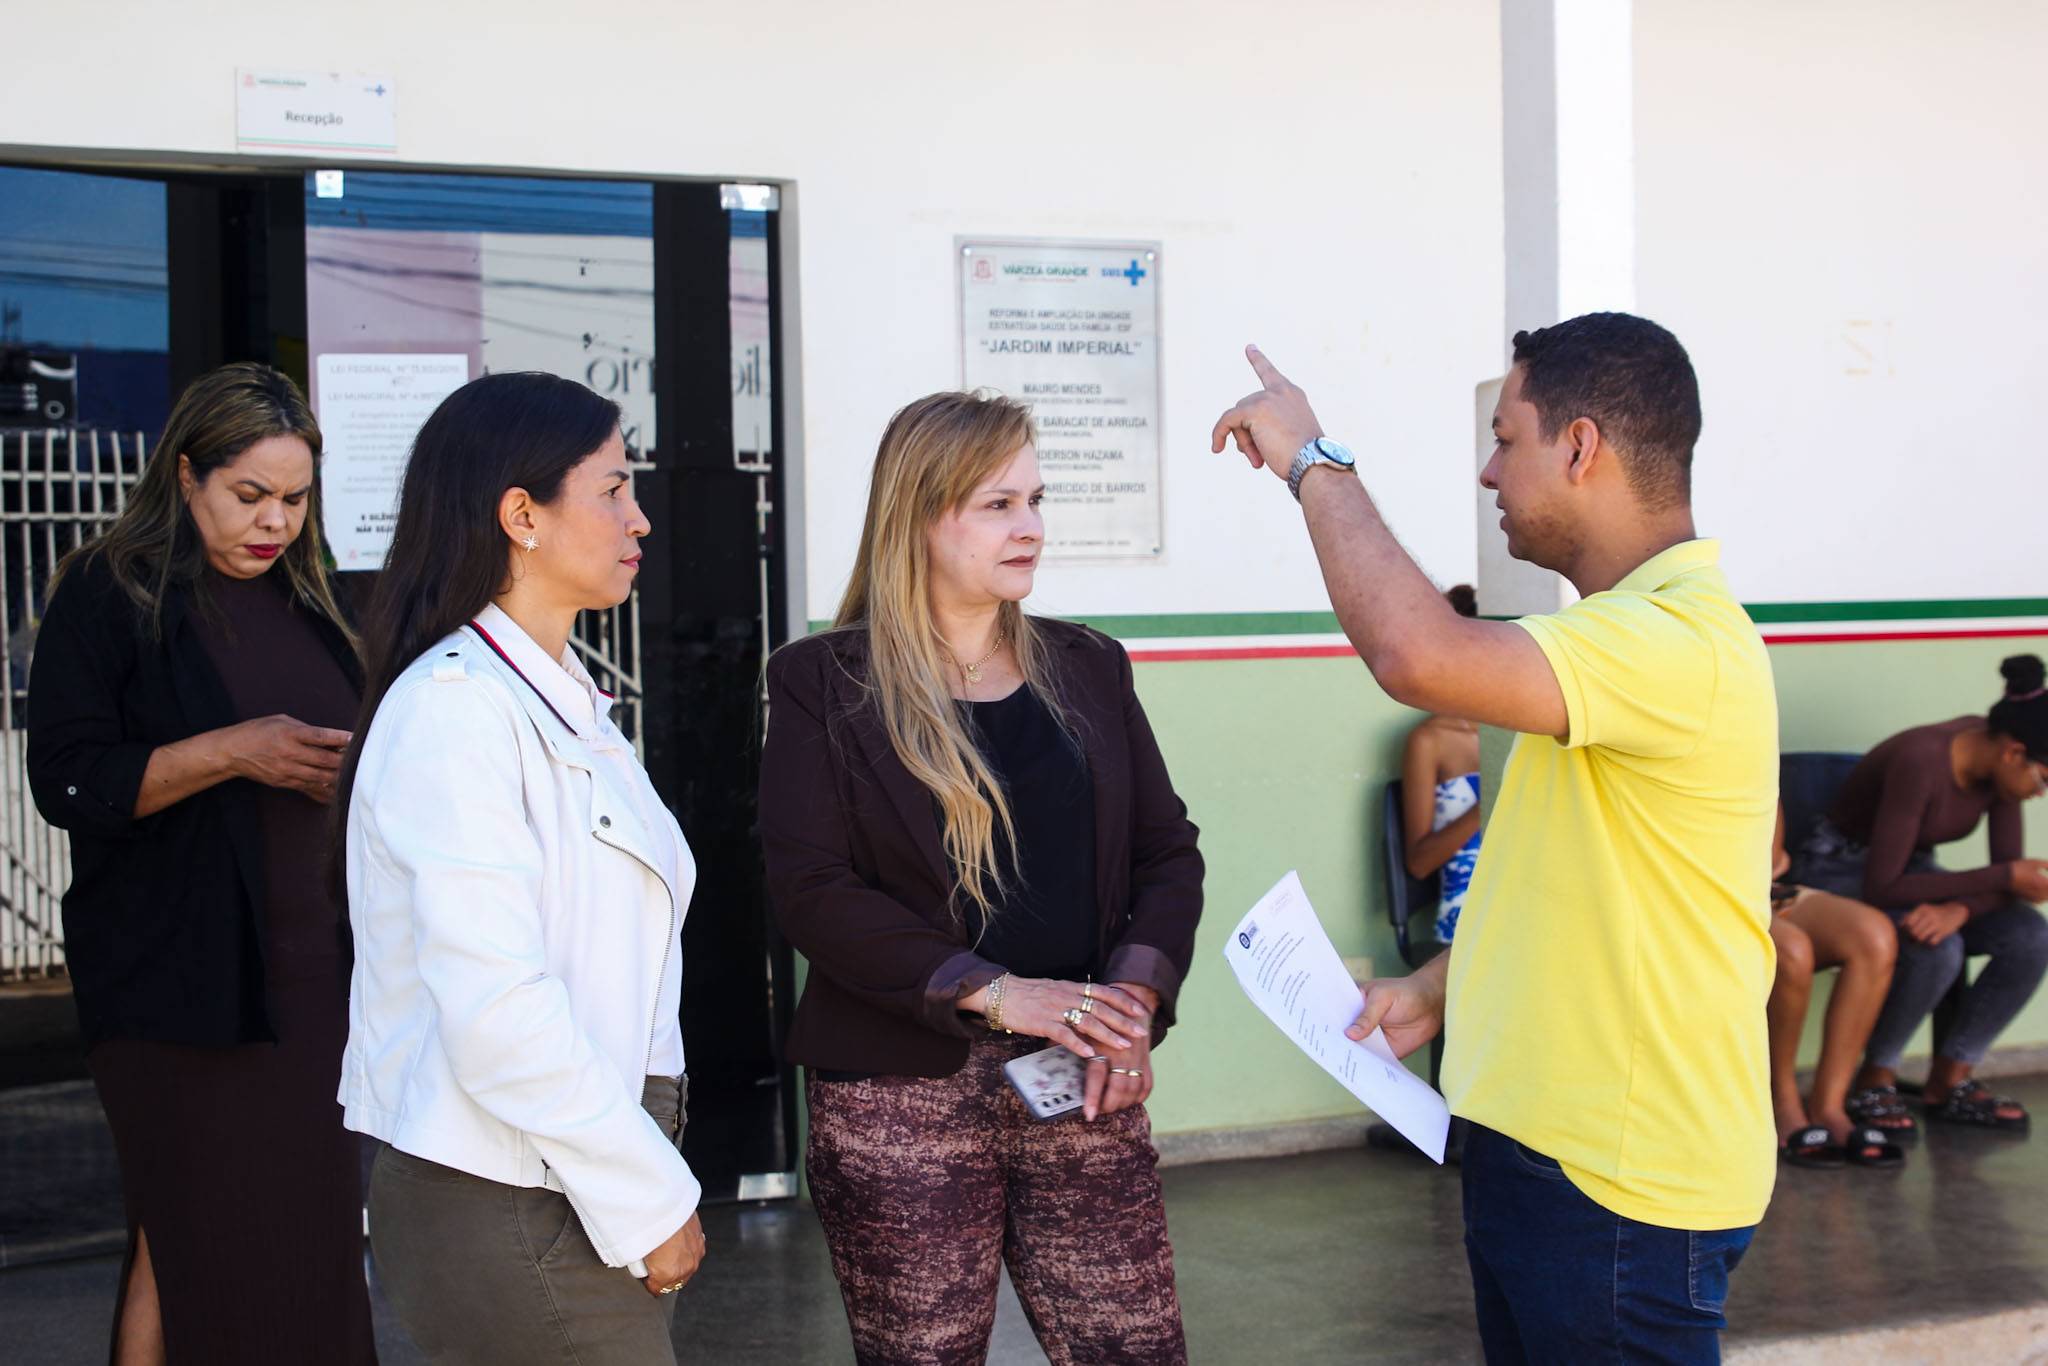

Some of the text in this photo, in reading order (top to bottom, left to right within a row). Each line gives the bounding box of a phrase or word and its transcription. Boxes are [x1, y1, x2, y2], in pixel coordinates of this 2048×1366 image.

[285, 110, 343, 125] Recepção
[1046, 265, 1089, 276] GRANDE
[989, 308, 1029, 319] REFORMA
[1098, 310, 1132, 320] UNIDADE
[1023, 383, 1102, 395] MAURO MENDES
[1043, 416, 1089, 428] BARACAT
[1091, 416, 1104, 428] DE
[1106, 417, 1148, 428] ARRUDA
[1038, 449, 1124, 461] DERSON HAZAMA
[1045, 482, 1147, 494] ARECIDO DE BARROS
